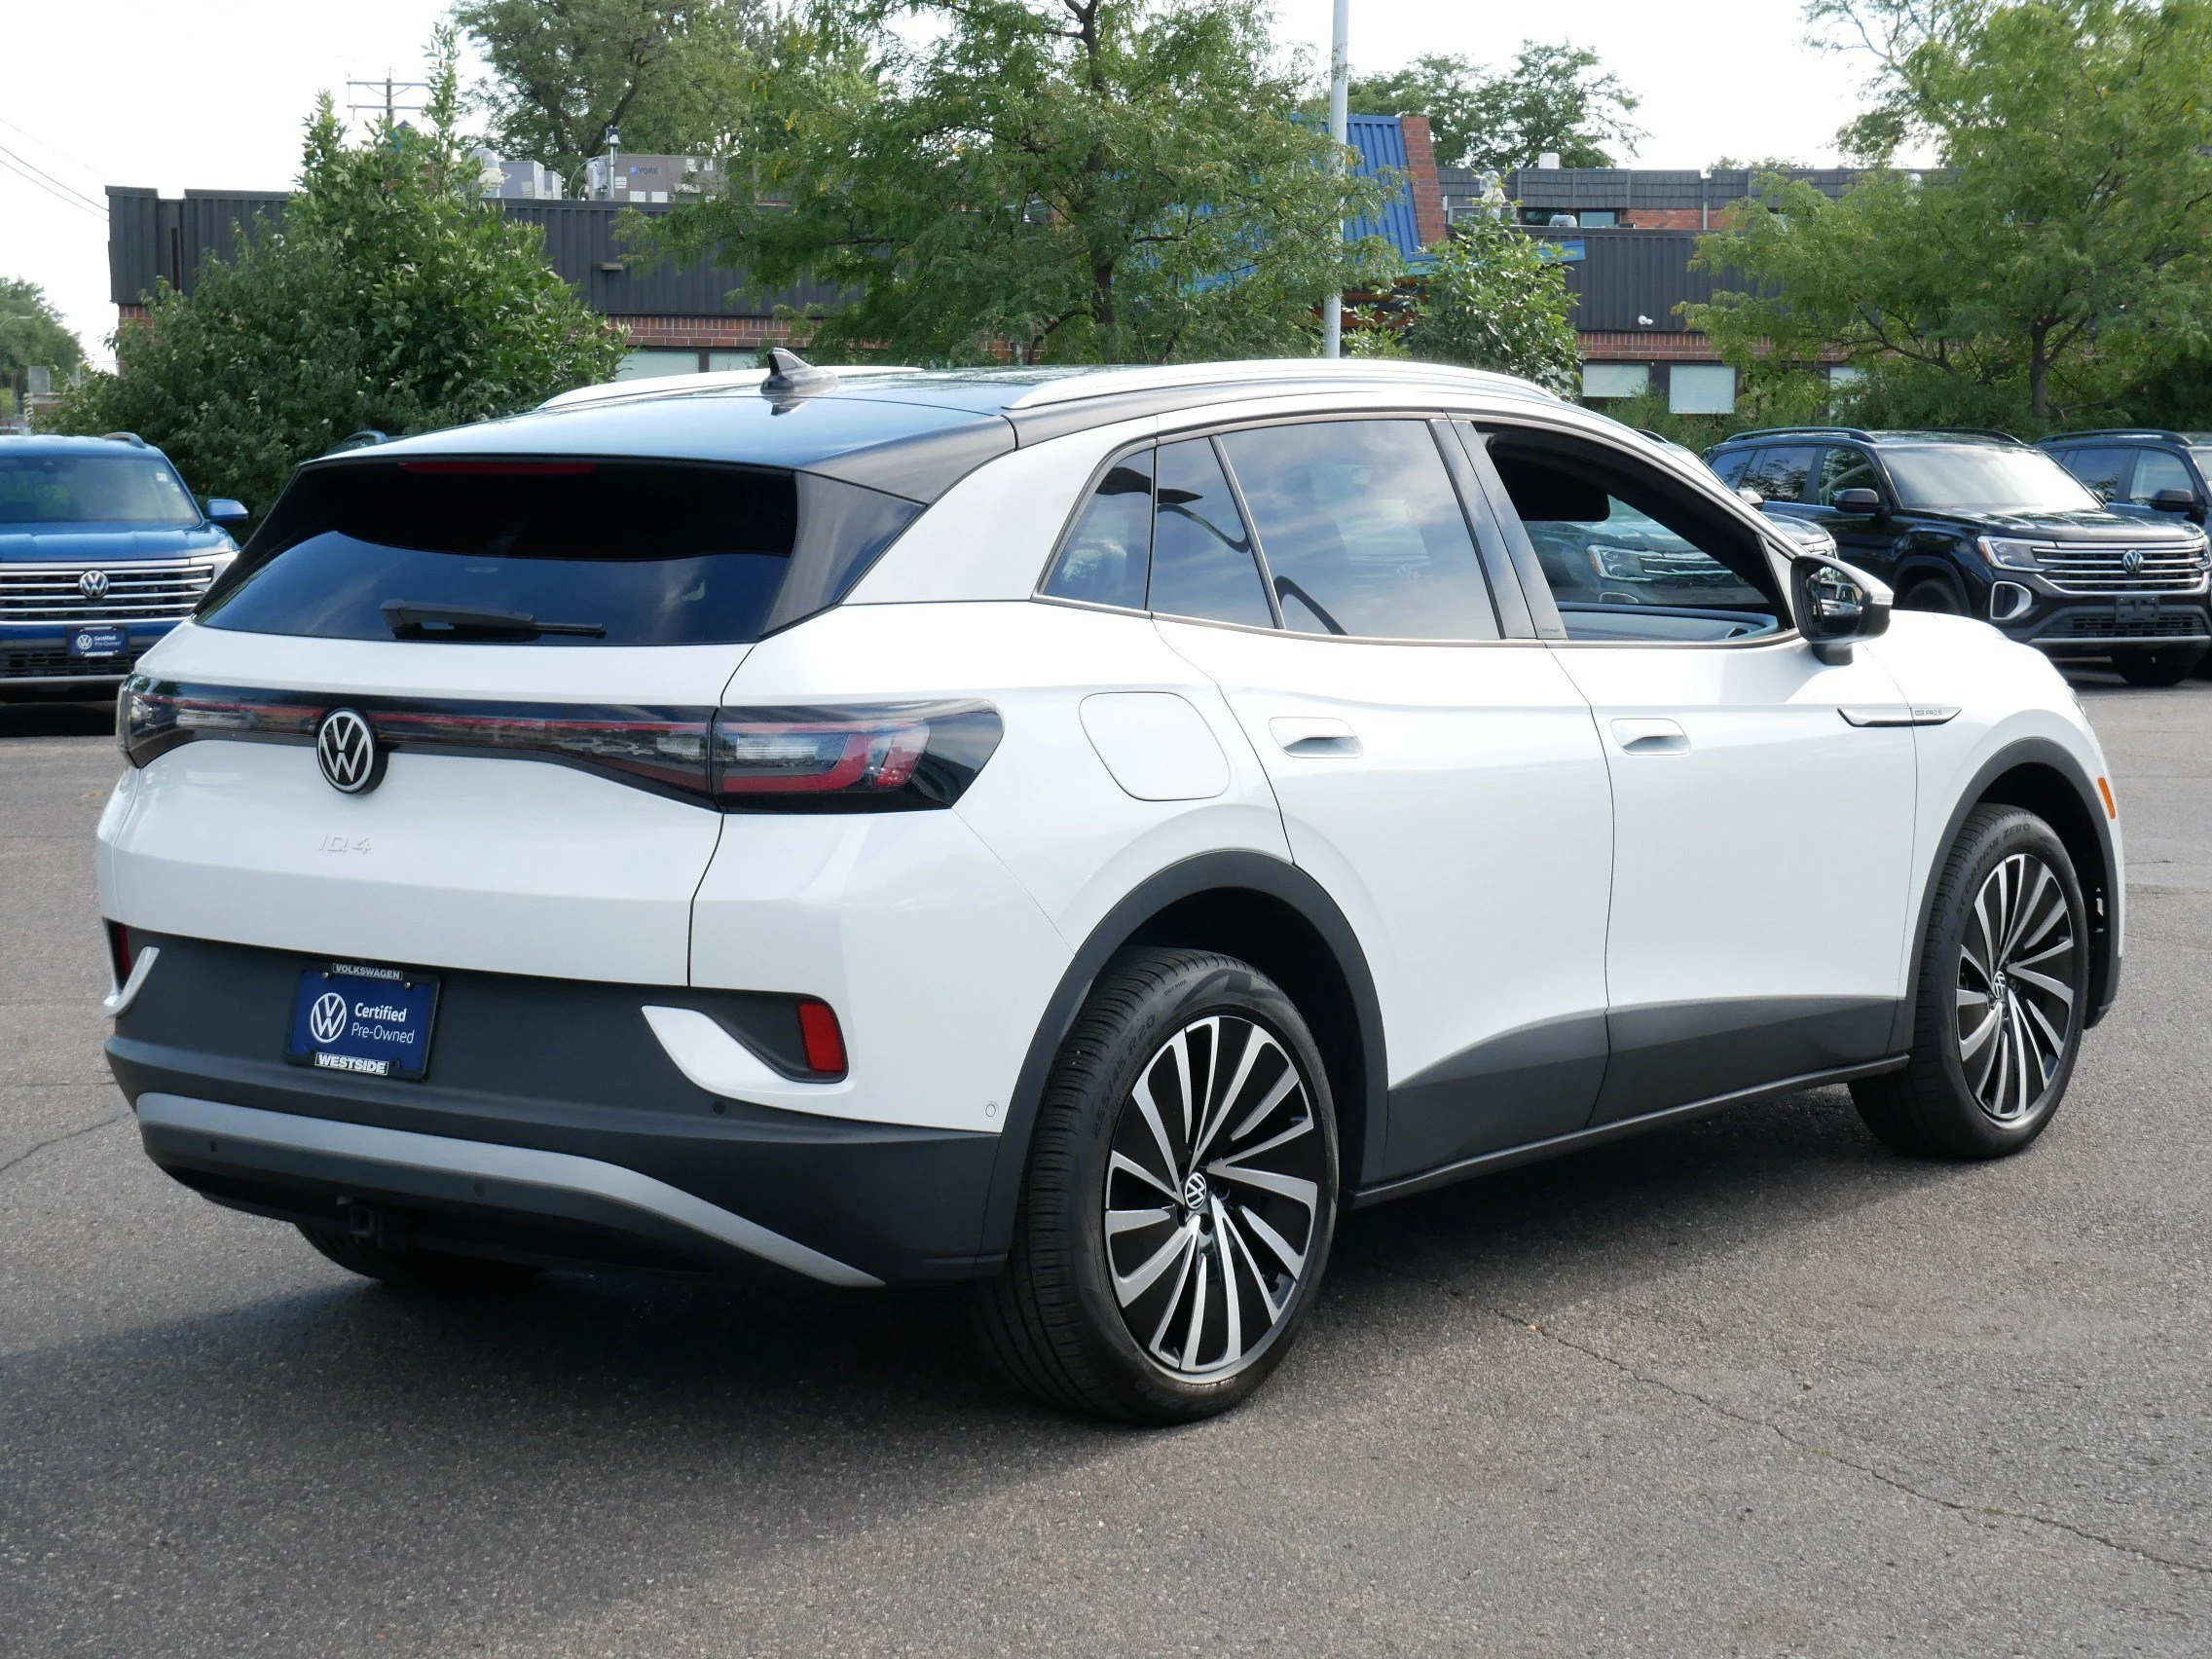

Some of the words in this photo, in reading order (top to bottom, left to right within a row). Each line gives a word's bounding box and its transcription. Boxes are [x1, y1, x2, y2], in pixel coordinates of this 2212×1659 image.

[639, 166, 659, 175] YORK
[318, 711, 374, 793] VW
[2003, 823, 2031, 840] ZERO
[335, 963, 401, 979] VOLKSWAGEN
[310, 992, 348, 1044] VW
[354, 1002, 408, 1022] Certified
[350, 1022, 416, 1045] Pre-Owned
[1126, 1014, 1156, 1056] R20
[317, 1053, 387, 1075] WESTSIDE
